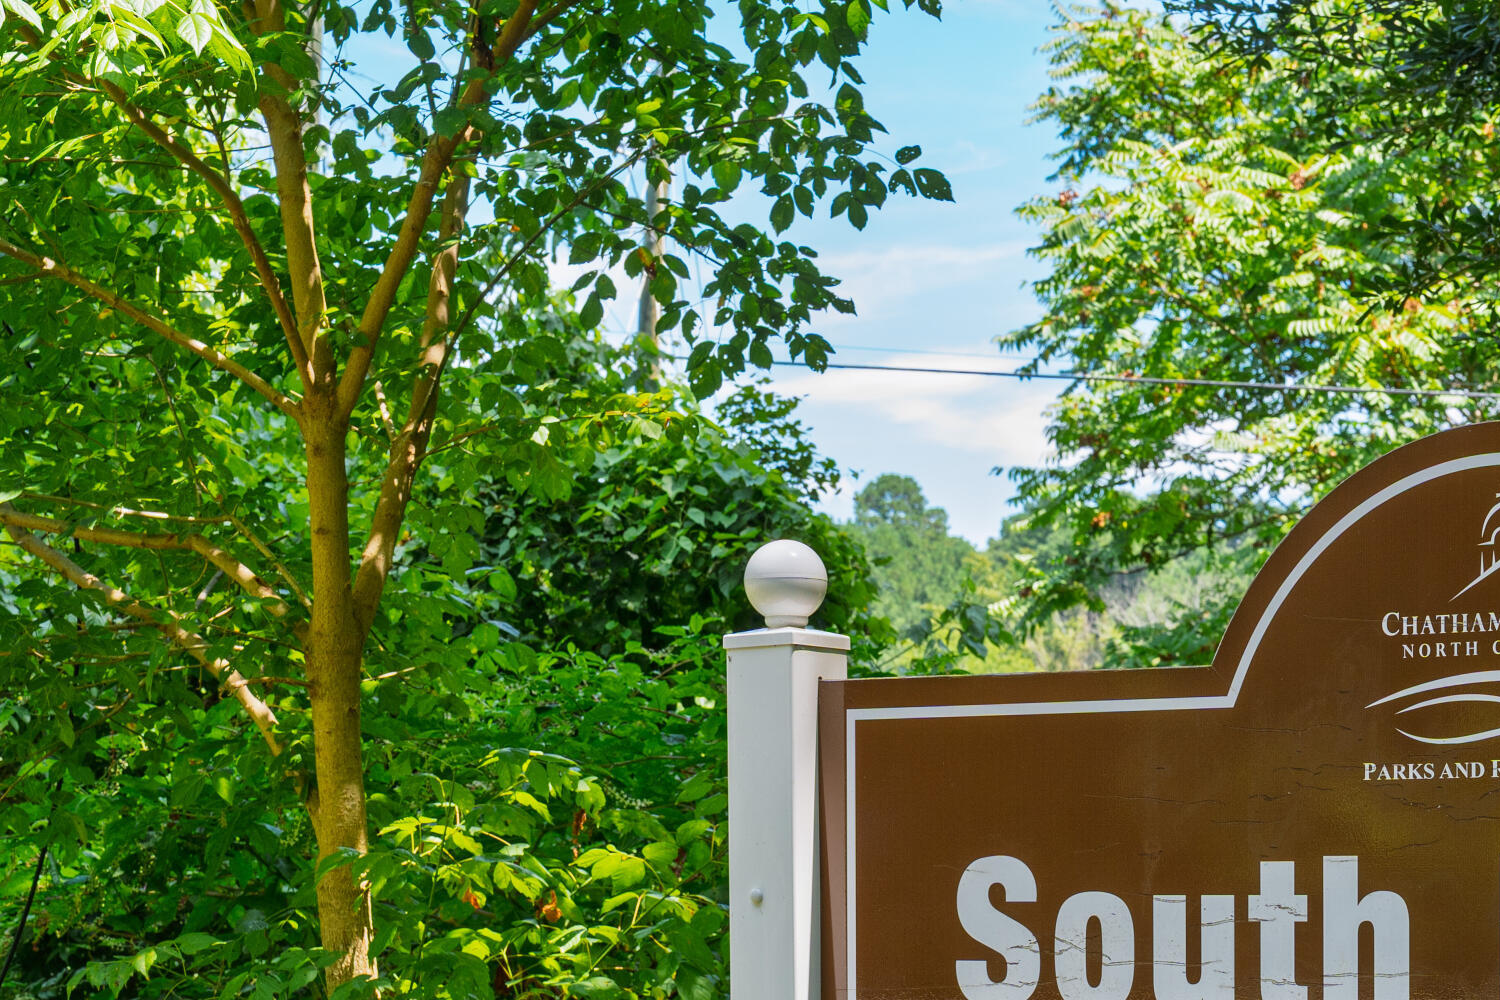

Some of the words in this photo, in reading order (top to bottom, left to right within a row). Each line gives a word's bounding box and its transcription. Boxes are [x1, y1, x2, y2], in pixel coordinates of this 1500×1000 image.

[1403, 641, 1477, 658] NORTH
[1364, 763, 1434, 780] PARKS
[1440, 762, 1485, 778] AND
